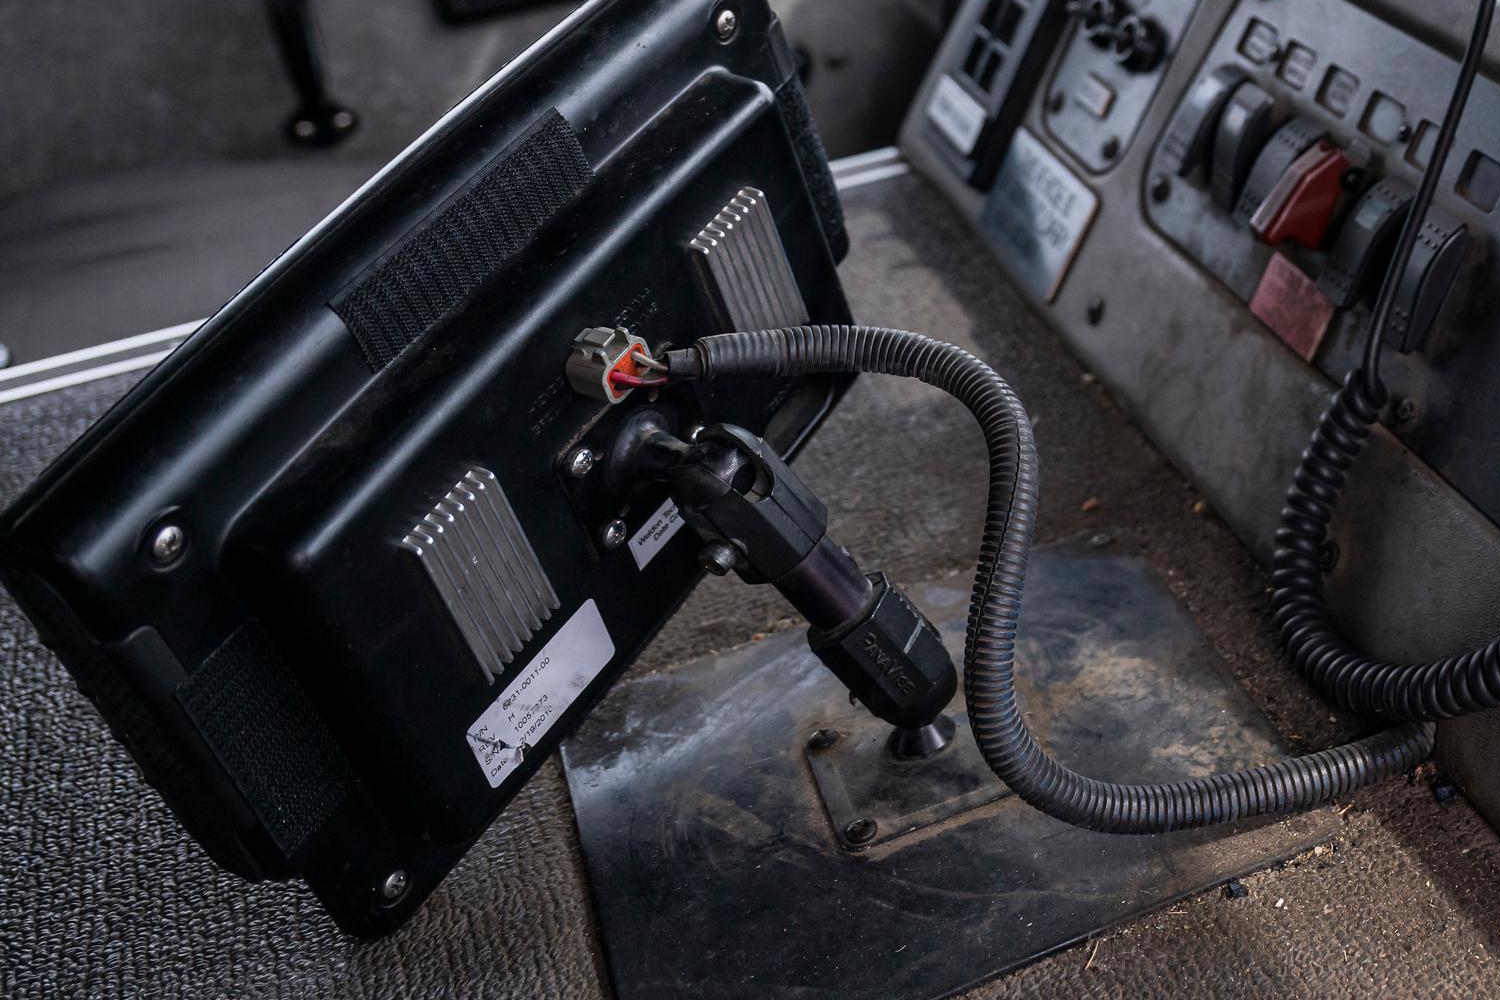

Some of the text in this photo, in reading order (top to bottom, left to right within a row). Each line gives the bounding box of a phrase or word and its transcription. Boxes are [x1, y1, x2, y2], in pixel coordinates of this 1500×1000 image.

[638, 519, 663, 546] Weldon
[653, 523, 669, 541] Date
[508, 712, 515, 722] H
